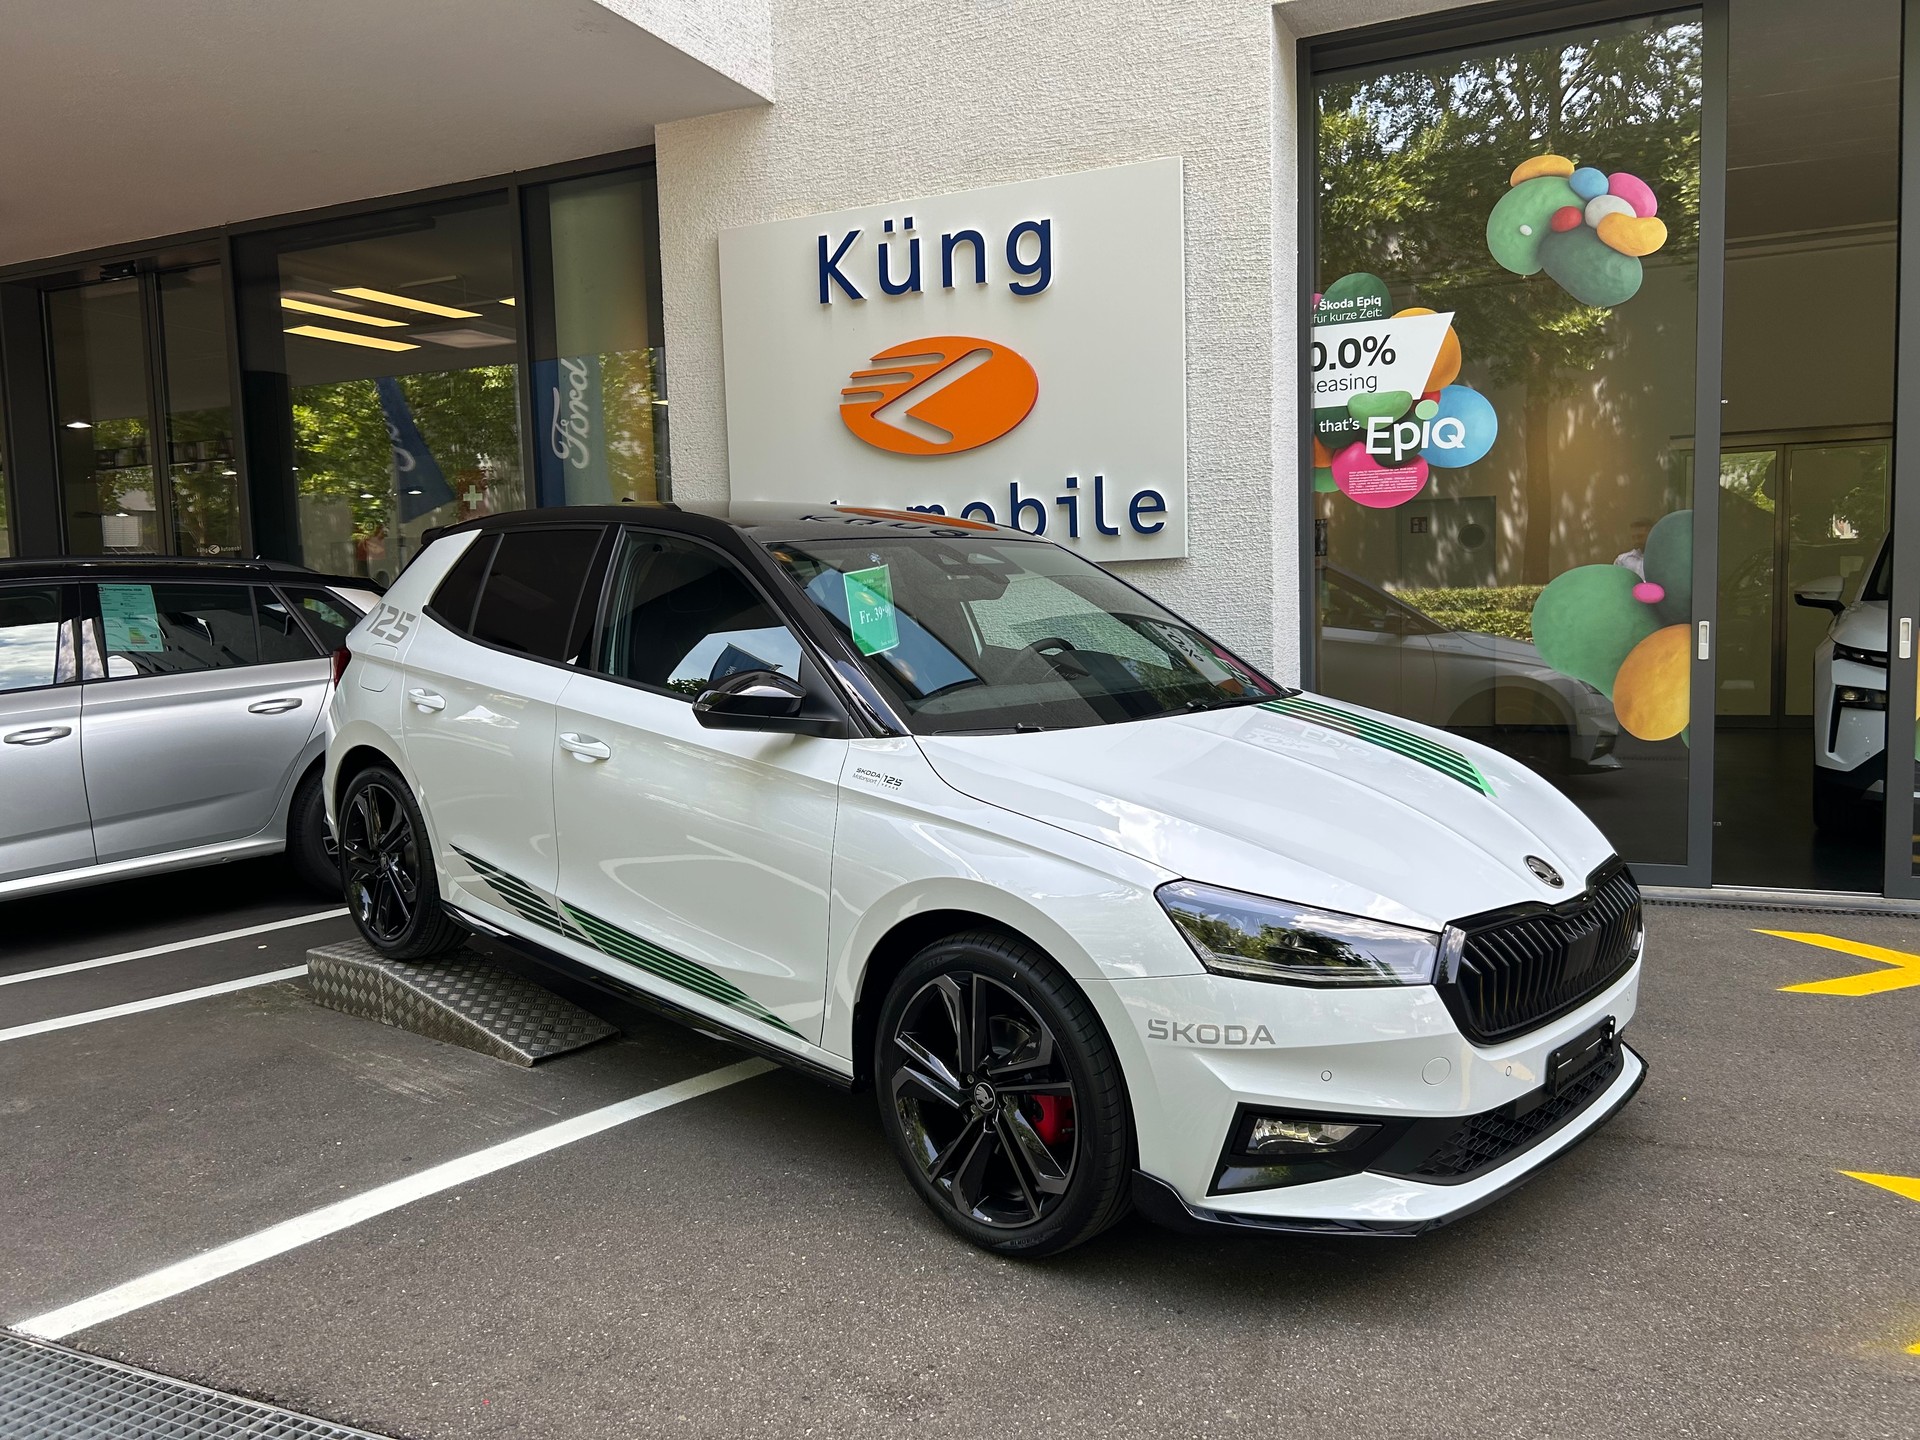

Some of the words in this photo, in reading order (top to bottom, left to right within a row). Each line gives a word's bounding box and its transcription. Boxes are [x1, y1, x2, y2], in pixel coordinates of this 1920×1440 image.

[818, 217, 1055, 305] Küng
[1319, 298, 1354, 311] Škoda
[1357, 294, 1382, 308] Epiq
[1313, 312, 1327, 324] für
[1329, 311, 1357, 322] kurze
[1360, 307, 1382, 319] Zeit:
[1313, 373, 1378, 394] easing
[551, 358, 590, 469] Ford
[1319, 417, 1360, 433] that's
[366, 603, 417, 644] 125
[883, 775, 904, 787] 125
